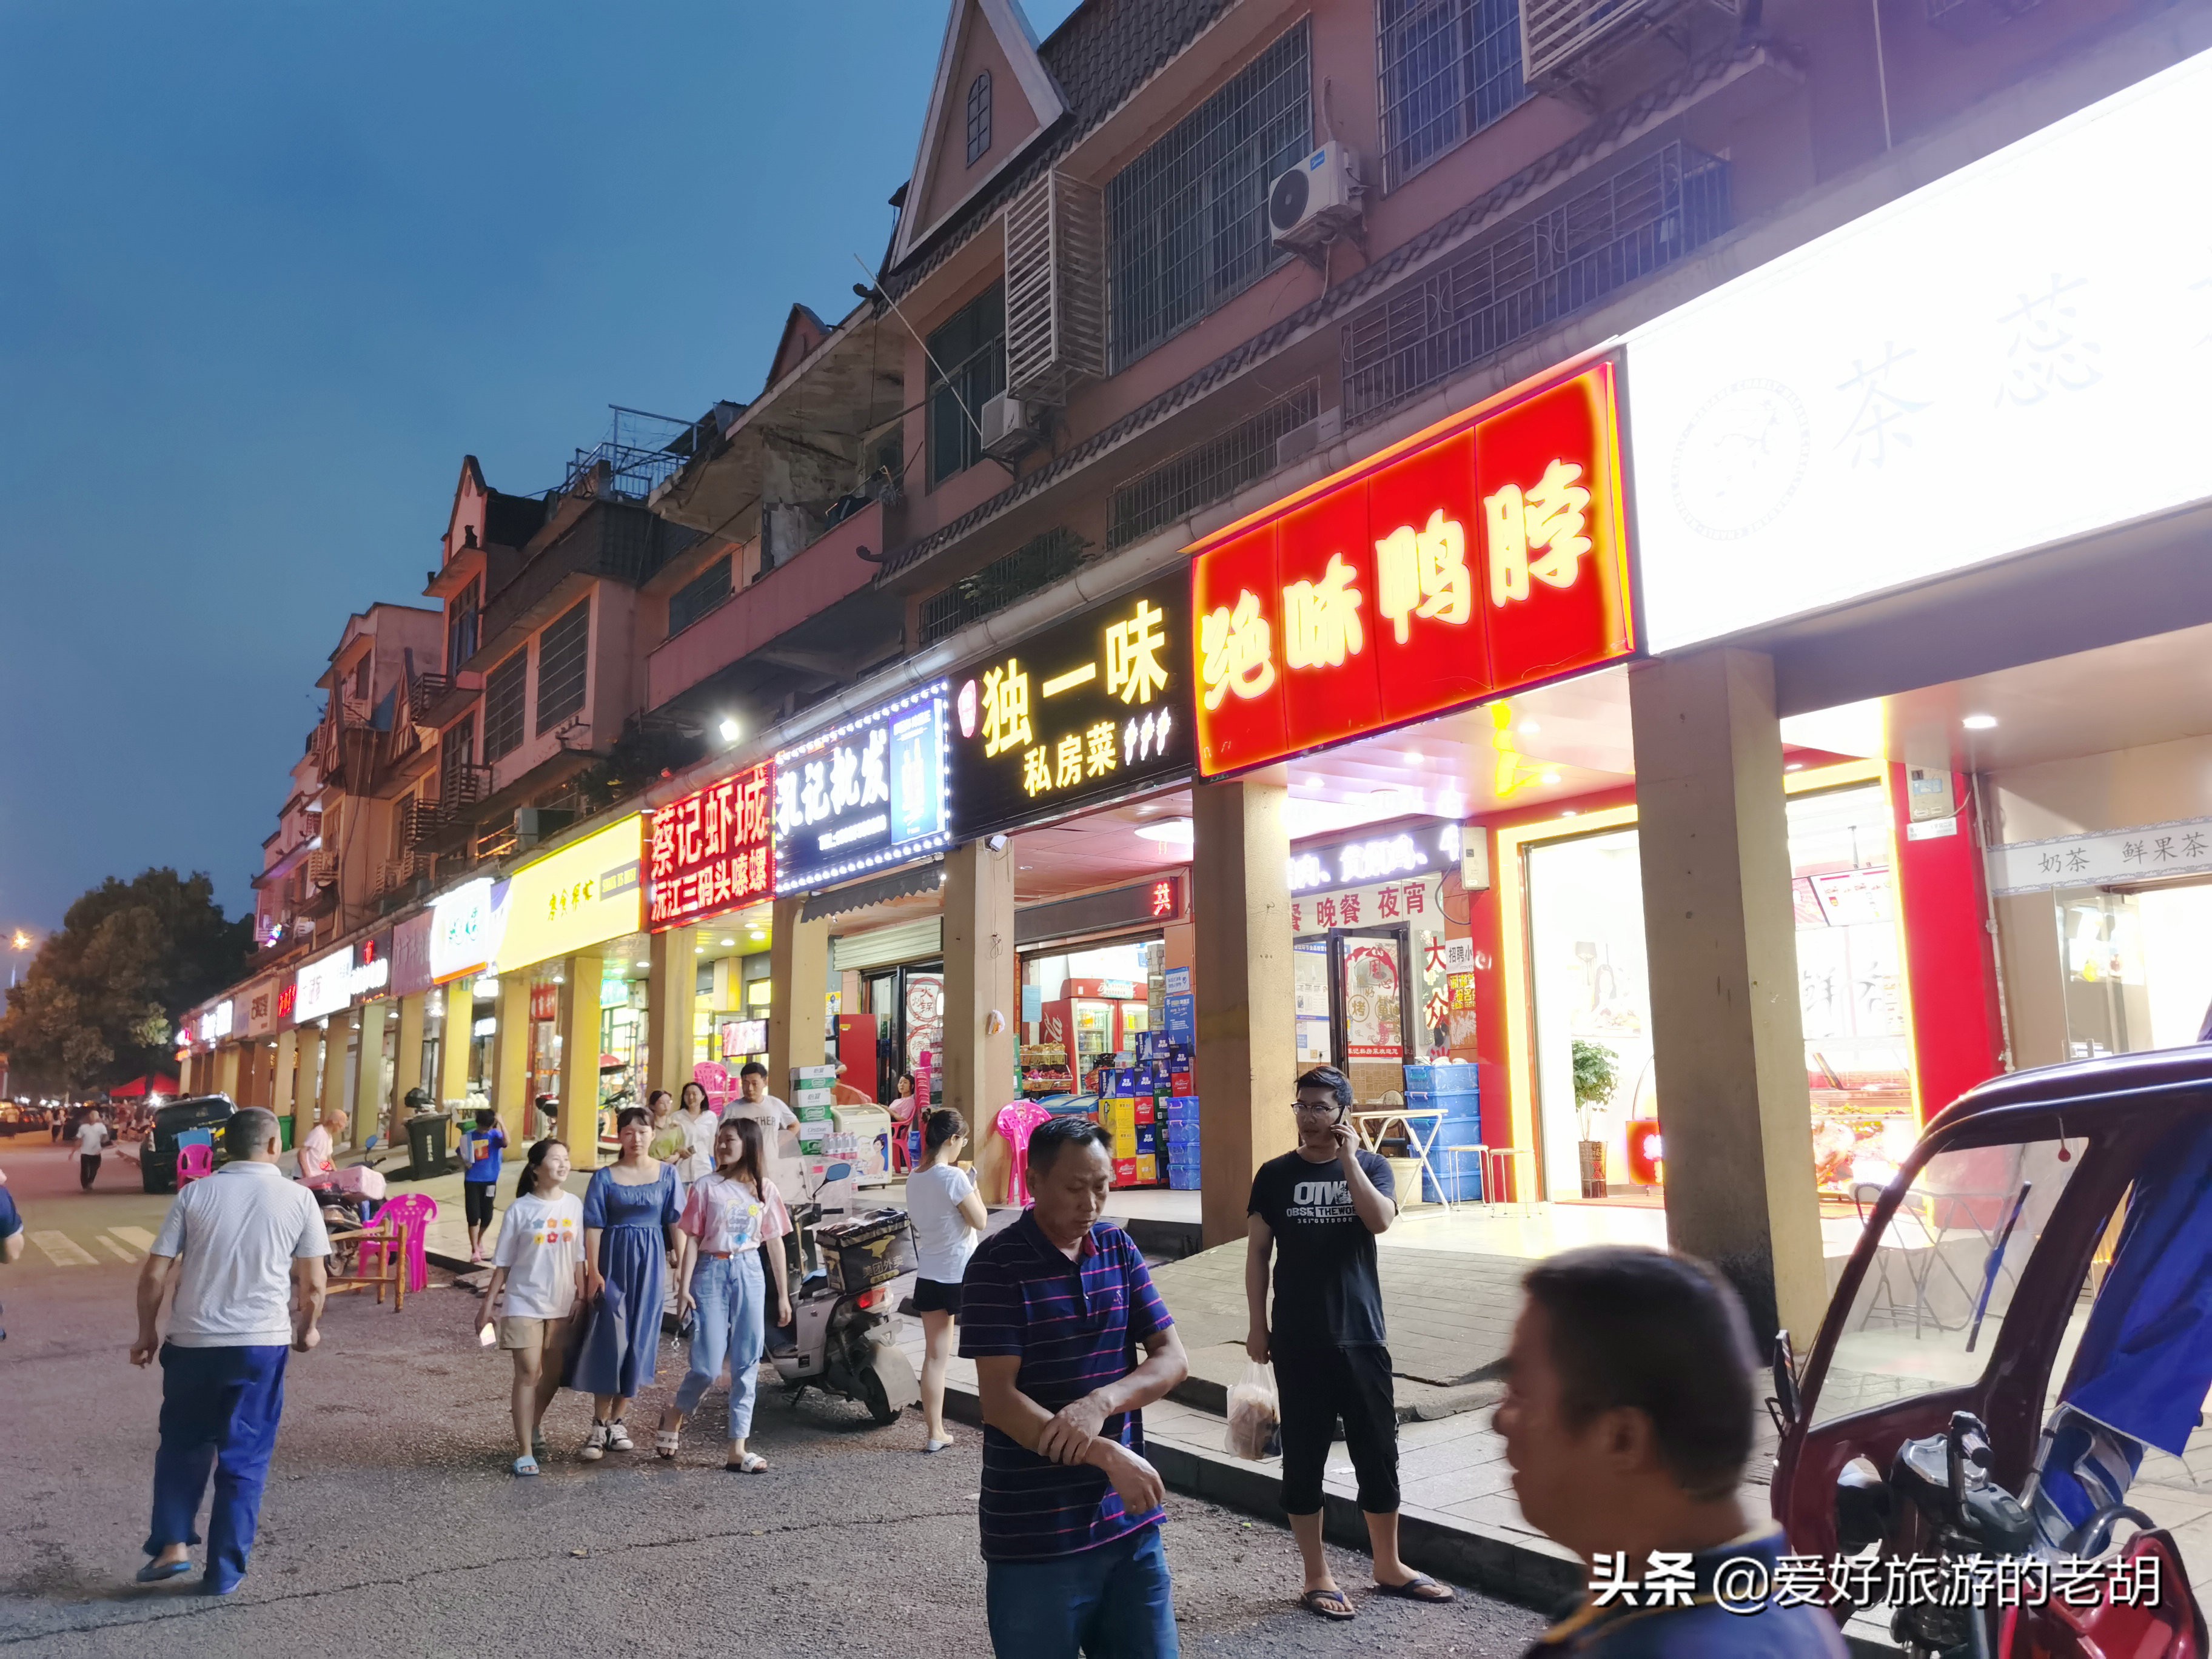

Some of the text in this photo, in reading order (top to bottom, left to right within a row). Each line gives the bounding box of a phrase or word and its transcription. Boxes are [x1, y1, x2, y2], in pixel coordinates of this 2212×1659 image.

[1201, 457, 1593, 711] 绝味鸭脖
[980, 599, 1168, 758] 独一味
[1024, 721, 1118, 797] 私房菜
[651, 766, 770, 880] 蔡记虾城
[2038, 832, 2208, 874] 奶茶 鲜果茶
[1316, 893, 1361, 928] 晚餐
[1378, 882, 1425, 919] 夜宵
[751, 1116, 776, 1127] THER
[863, 1255, 903, 1279] 美团外卖
